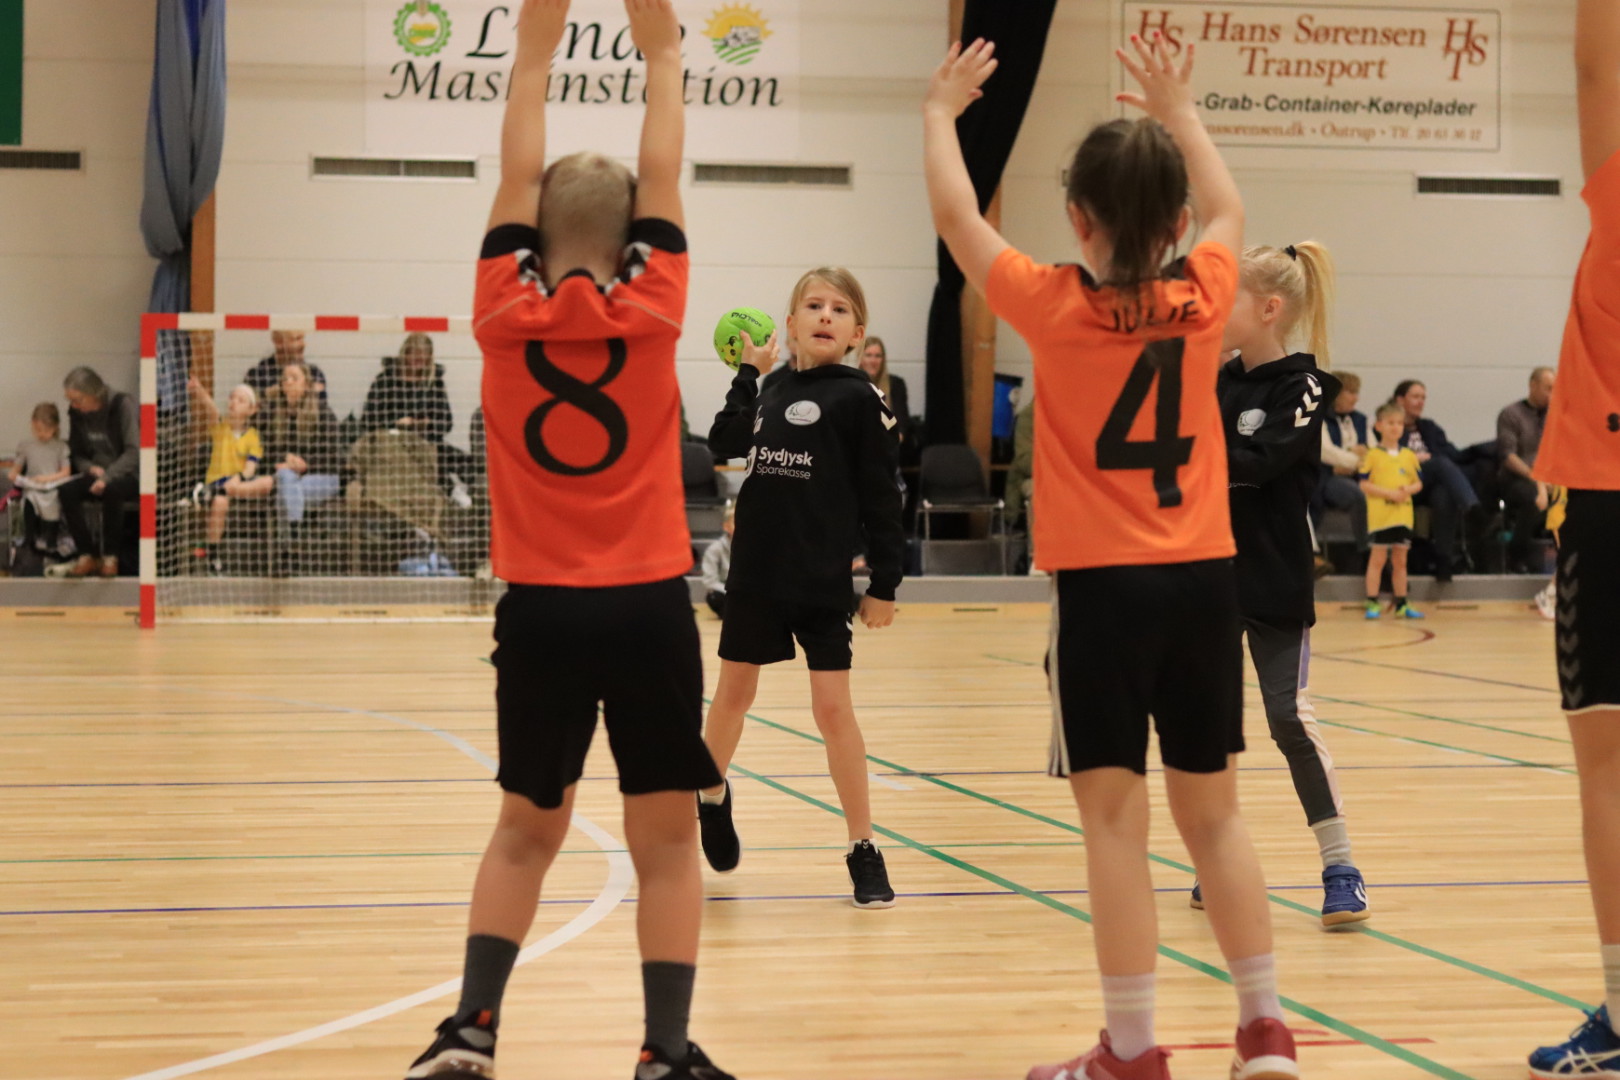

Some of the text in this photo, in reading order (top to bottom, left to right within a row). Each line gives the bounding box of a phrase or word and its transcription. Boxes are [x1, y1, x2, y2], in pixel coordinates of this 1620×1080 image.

[1199, 11, 1427, 47] Hans Sørensen
[1239, 46, 1388, 86] Transport
[524, 337, 628, 476] 8
[1095, 336, 1196, 508] 4
[756, 463, 811, 480] Sparekasse
[759, 446, 814, 467] Sydjysk
